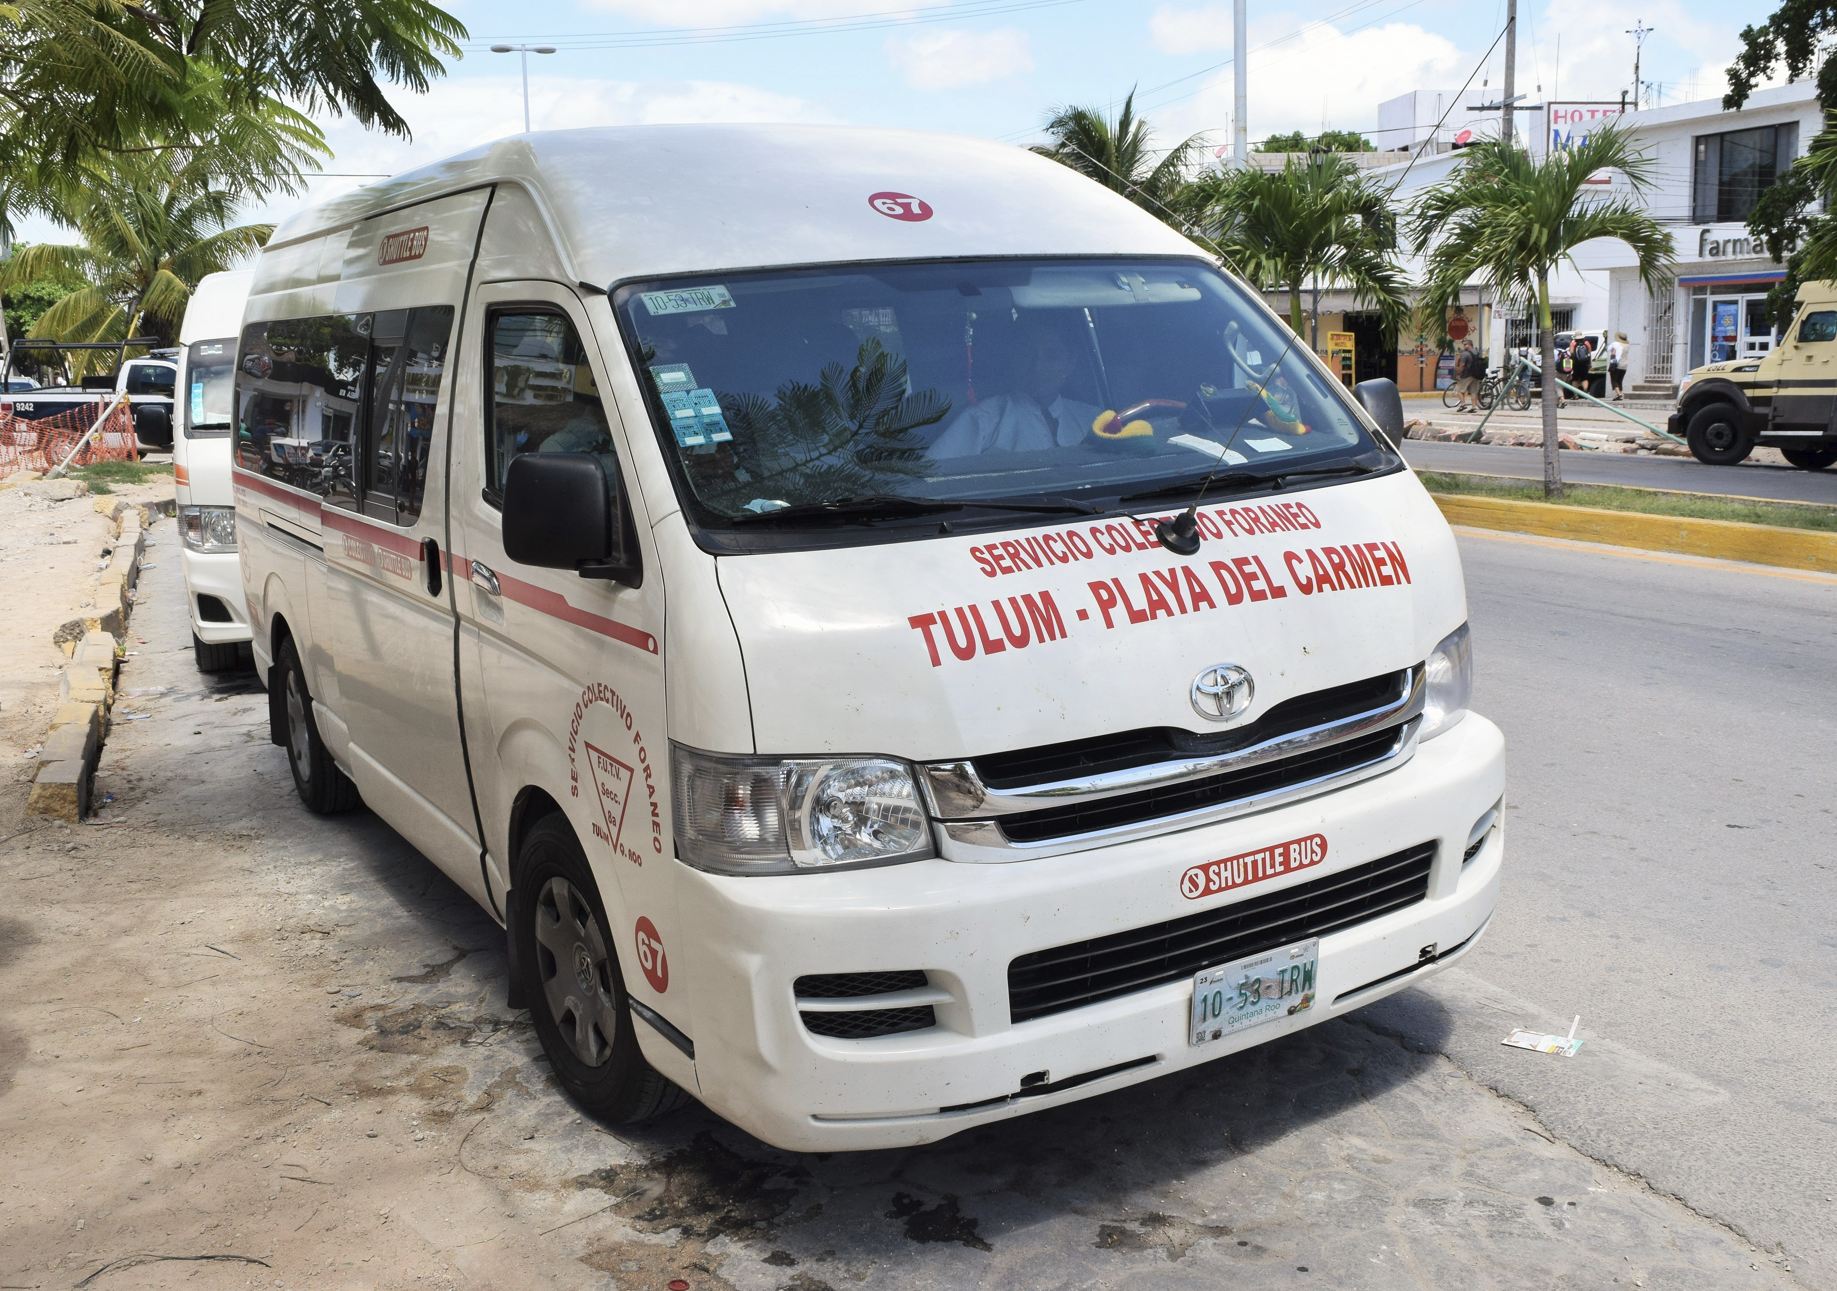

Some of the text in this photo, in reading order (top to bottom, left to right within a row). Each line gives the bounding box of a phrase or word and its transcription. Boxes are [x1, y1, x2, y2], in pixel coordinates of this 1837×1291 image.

[1553, 109, 1625, 124] HOT
[873, 198, 922, 215] 67
[1699, 228, 1809, 258] farmaa
[15, 402, 34, 411] 9242
[970, 502, 1322, 578] SERVICIO COLEO FORANEO
[907, 590, 1068, 667] TULUM
[1087, 565, 1216, 629] PLAYA
[1208, 555, 1288, 606] DEL
[1283, 541, 1412, 596] CARMEN
[582, 682, 633, 731] COLECTIVO
[633, 730, 662, 854] FORANEO
[601, 782, 621, 805] Secc.
[1208, 847, 1285, 891] SHUTTLE
[1289, 837, 1322, 869] BUS
[637, 930, 664, 978] 67
[1228, 1008, 1263, 1025] Quintana
[1264, 1003, 1281, 1013] Roo
